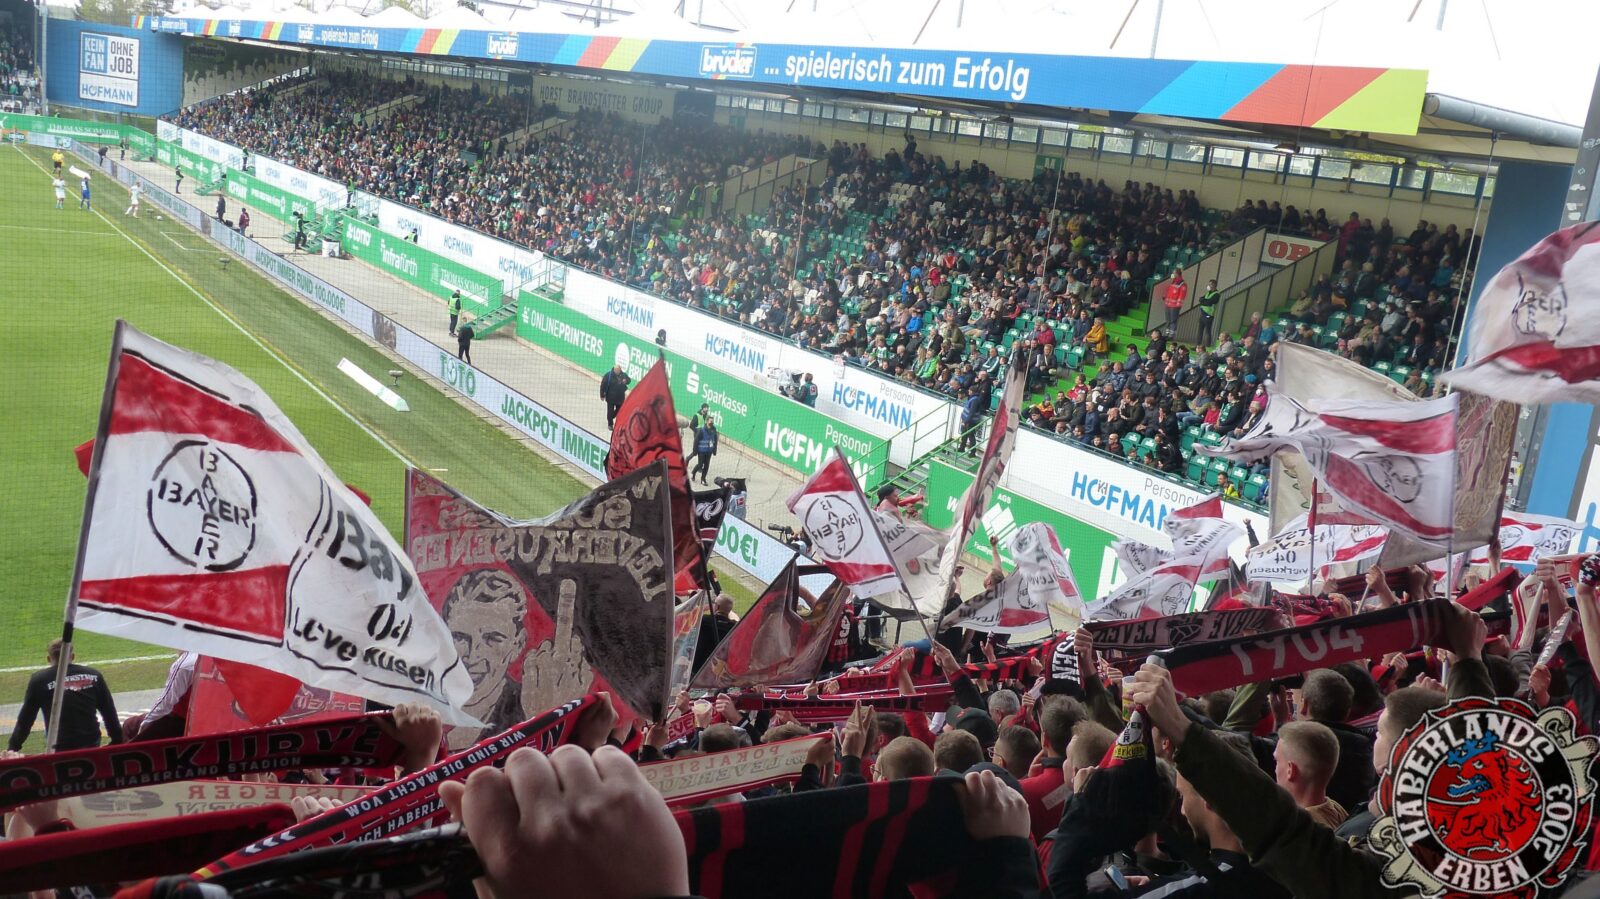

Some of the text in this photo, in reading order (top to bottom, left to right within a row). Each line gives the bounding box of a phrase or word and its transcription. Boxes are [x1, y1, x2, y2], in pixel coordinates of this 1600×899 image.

[84, 38, 105, 53] KEIN
[110, 41, 134, 57] OHNE
[84, 52, 105, 71] FAN
[110, 57, 136, 75] JOB.
[701, 51, 753, 75] bruder
[785, 51, 892, 83] spielerisch
[899, 60, 945, 86] zum
[952, 57, 1031, 101] Erfolg
[82, 83, 133, 102] HOFMANN
[540, 86, 663, 113] HORST BRANDSTÄTTER GROUP
[443, 234, 473, 257] HOFMANN
[1268, 239, 1312, 262] OB
[256, 252, 277, 272] JACKPOT
[277, 260, 296, 283] IMMER
[297, 272, 314, 294] RUND
[381, 246, 418, 277] infrafürth
[499, 255, 533, 282] HOFMANN
[440, 267, 463, 291] THOMAS
[606, 295, 654, 329] HOFMANN
[529, 309, 603, 357] ONLINEPRINTERS
[705, 332, 765, 373] HOFMANN
[439, 351, 478, 397] TOTO
[702, 383, 748, 417] Sparkasse
[832, 381, 912, 431] HOFMANN
[879, 382, 915, 405] Personal
[502, 393, 559, 444] JACKPOT
[825, 424, 872, 456] Personal
[157, 478, 251, 529] BAYER
[195, 449, 219, 559] BAYER
[1230, 626, 1365, 676] 1904
[467, 744, 498, 764] SIND
[500, 729, 526, 749] WIR
[0, 723, 386, 796] ORDKURVE
[441, 761, 464, 777] DIE
[38, 756, 301, 797] ULRICH HABERLAND STADION
[389, 771, 439, 801] MACHT
[345, 799, 384, 818] VOM
[388, 800, 446, 831] HABERLA
